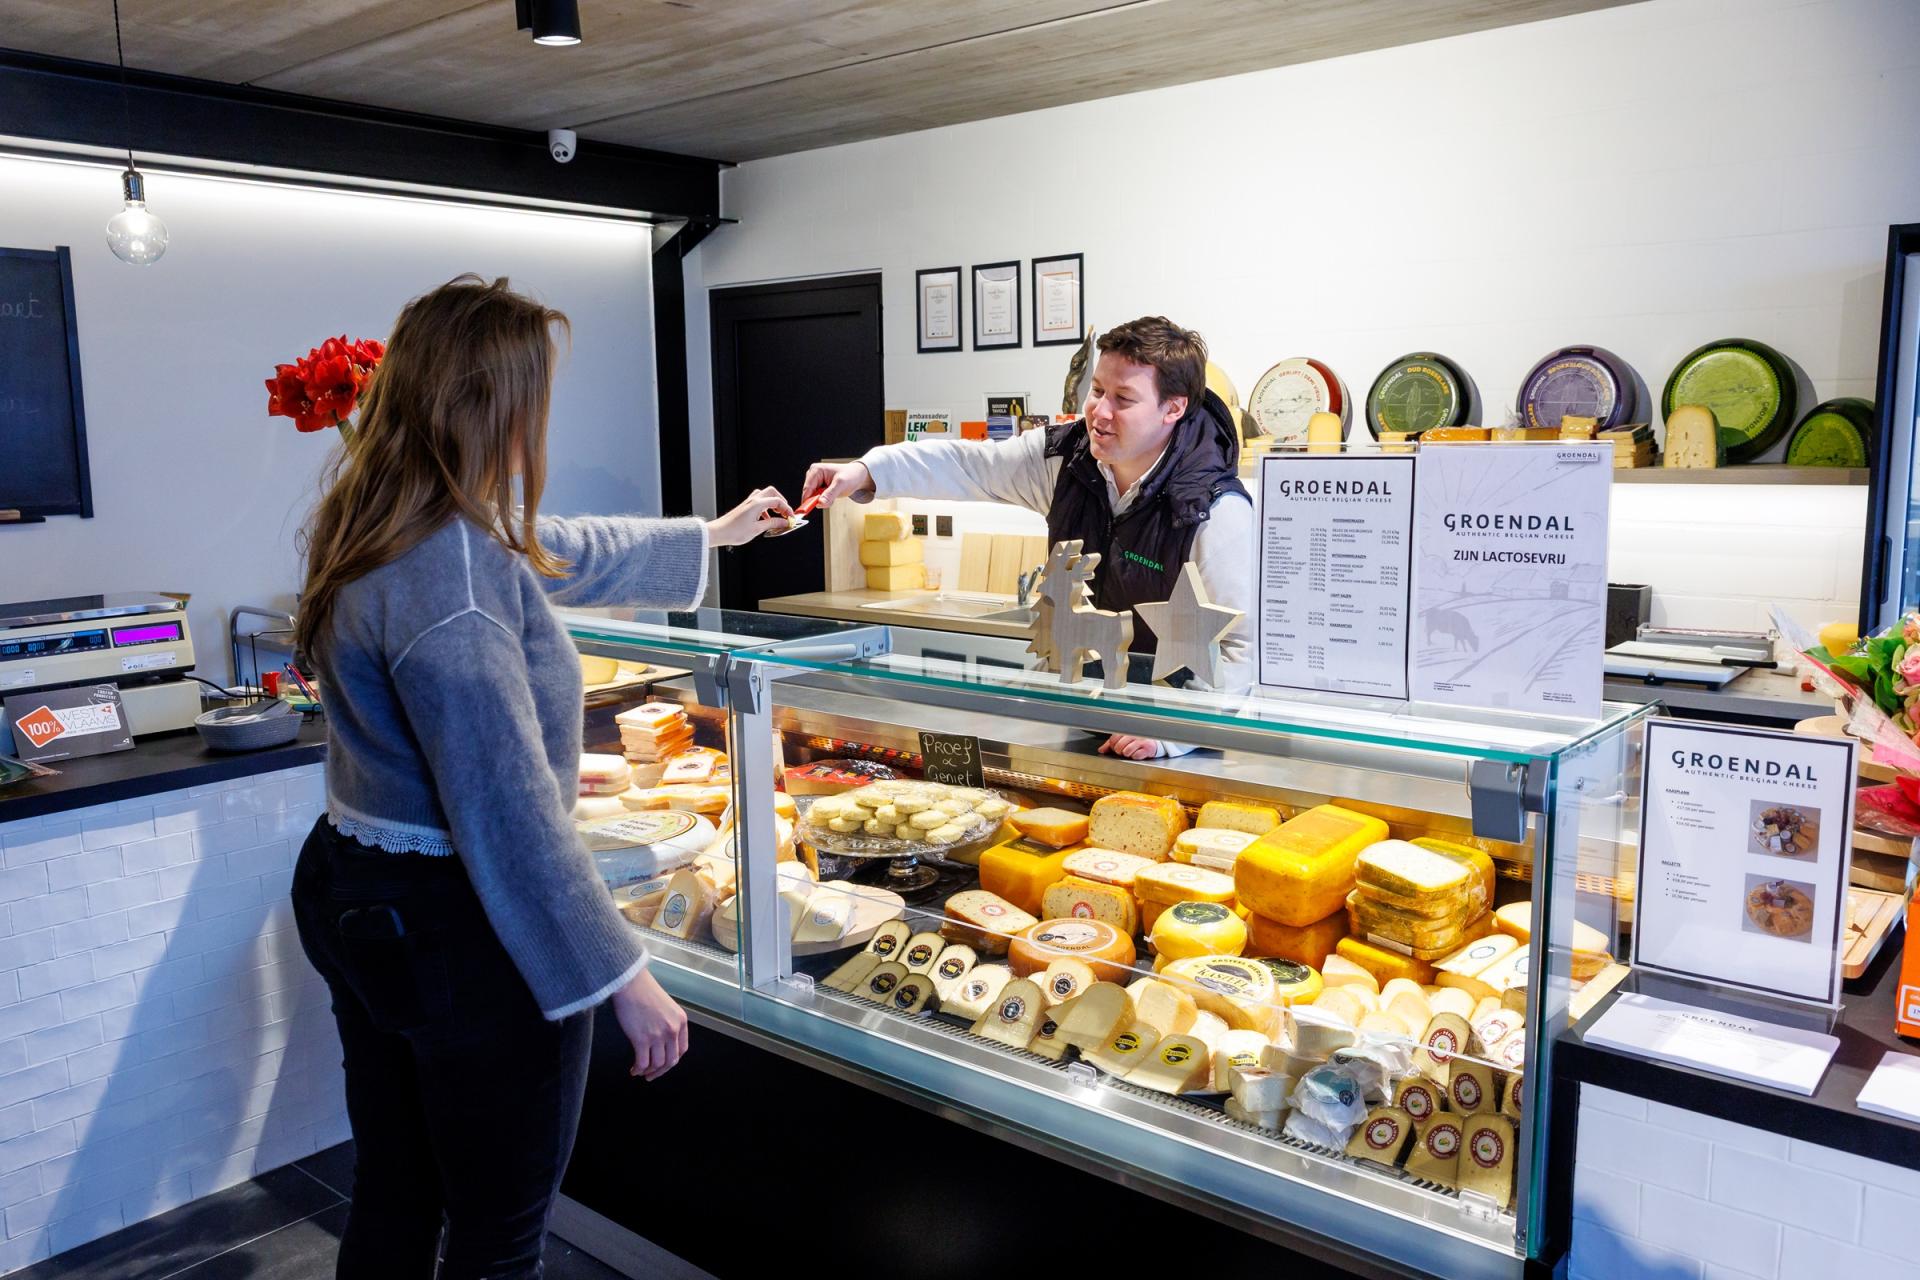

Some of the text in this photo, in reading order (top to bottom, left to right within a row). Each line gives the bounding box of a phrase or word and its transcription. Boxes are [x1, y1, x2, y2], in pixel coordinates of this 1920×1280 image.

[1407, 366, 1422, 374] OUD
[1378, 371, 1404, 400] GROENDAL
[1744, 400, 1771, 434] GROENDA
[908, 421, 949, 433] LEKR
[1280, 480, 1392, 497] GROENDAL
[1443, 513, 1575, 532] GROENDAL
[1124, 550, 1165, 572] GROENDAL
[1453, 549, 1567, 565] ZIJN LACTOSEVRIJ
[56, 706, 98, 722] WEST
[63, 714, 117, 731] VLAAMS
[26, 720, 61, 737] 100%
[1671, 750, 1818, 782] GROENDAL
[1685, 769, 1818, 790] AUTHENTIC BELGIAN CHEESE
[1681, 1012, 1754, 1032] GROENDAL
